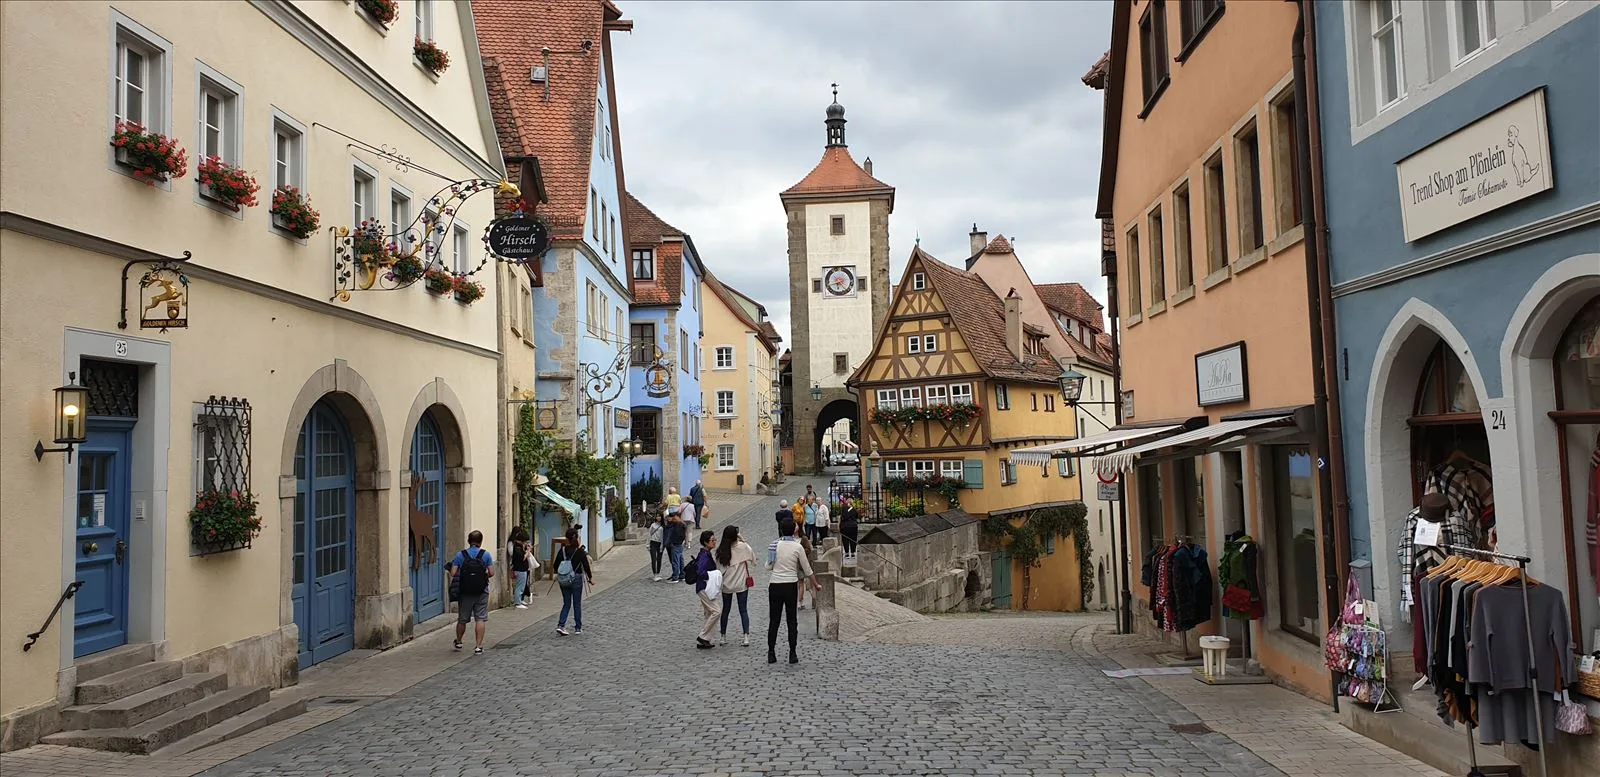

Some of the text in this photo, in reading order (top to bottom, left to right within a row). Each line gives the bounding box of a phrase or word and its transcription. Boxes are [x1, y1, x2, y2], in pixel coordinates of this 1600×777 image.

[1410, 145, 1507, 205] Trend Shop am Plönlein
[505, 225, 531, 233] Goldener
[500, 233, 537, 246] Hirsch
[502, 247, 534, 255] Gästehaus
[116, 341, 126, 354] 25
[1491, 410, 1506, 430] 24
